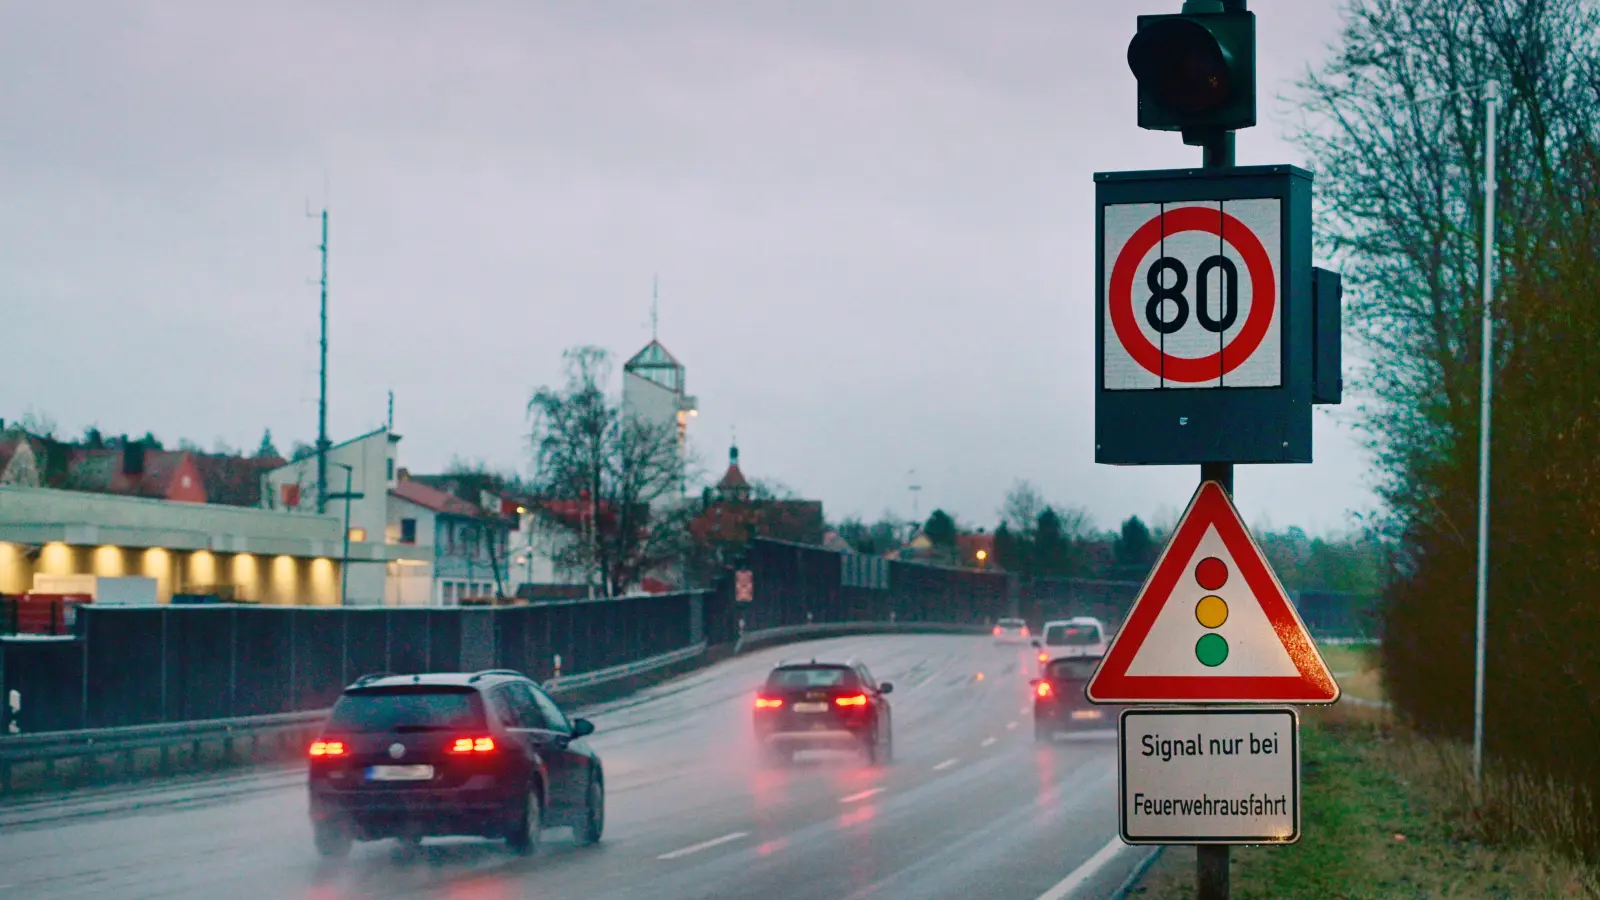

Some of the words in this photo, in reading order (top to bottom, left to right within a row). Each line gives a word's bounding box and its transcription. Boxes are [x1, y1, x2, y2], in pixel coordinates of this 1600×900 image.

[1145, 254, 1238, 334] 80
[1141, 733, 1204, 762] Signal
[1210, 738, 1243, 755] nur
[1250, 732, 1278, 755] bei
[1134, 793, 1287, 816] Feuerwehrausfahrt
